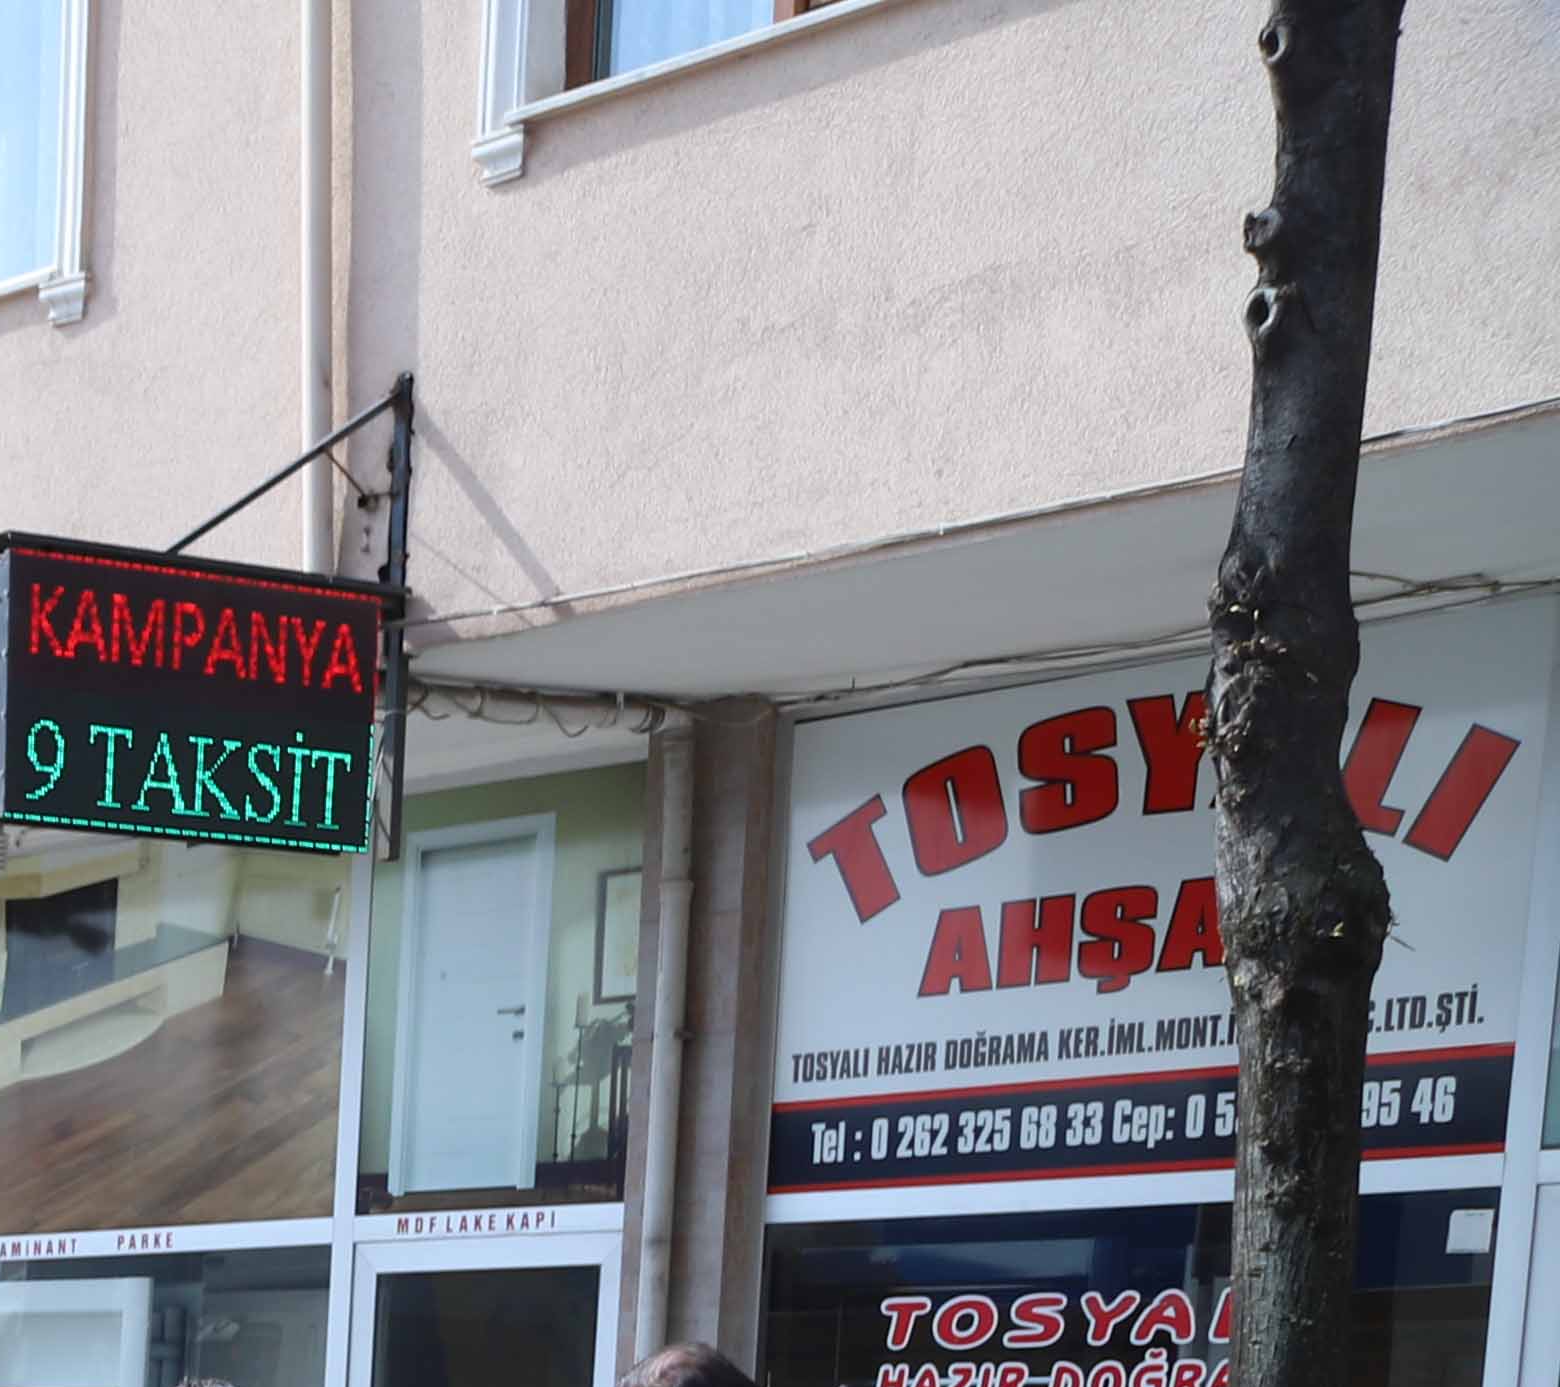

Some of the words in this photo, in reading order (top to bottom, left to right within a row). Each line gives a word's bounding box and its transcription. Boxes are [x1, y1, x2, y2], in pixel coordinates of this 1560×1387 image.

[28, 582, 363, 693] KAMPANYA
[25, 718, 65, 800] 9
[88, 722, 352, 830] TAKSİT
[807, 692, 1522, 924] TOSYLI
[918, 876, 1226, 999] AHŞA
[791, 1052, 869, 1085] TOSYALI
[876, 1041, 937, 1076] HAZIR
[944, 1030, 1049, 1070] DOĞRAMA
[811, 1122, 845, 1165] Tel
[871, 1116, 888, 1161] 0
[896, 1111, 949, 1160] 262
[957, 1107, 1012, 1154] 325
[1019, 1104, 1057, 1150] 68
[1065, 1101, 1103, 1147] 33
[1113, 1096, 1175, 1149] Cep:
[1185, 1094, 1206, 1139] 0
[1411, 1075, 1457, 1125] 46
[116, 1231, 175, 1251] PARKE
[396, 1216, 438, 1235] MDF
[446, 1213, 497, 1232] LAKE
[504, 1210, 558, 1231] KAPI
